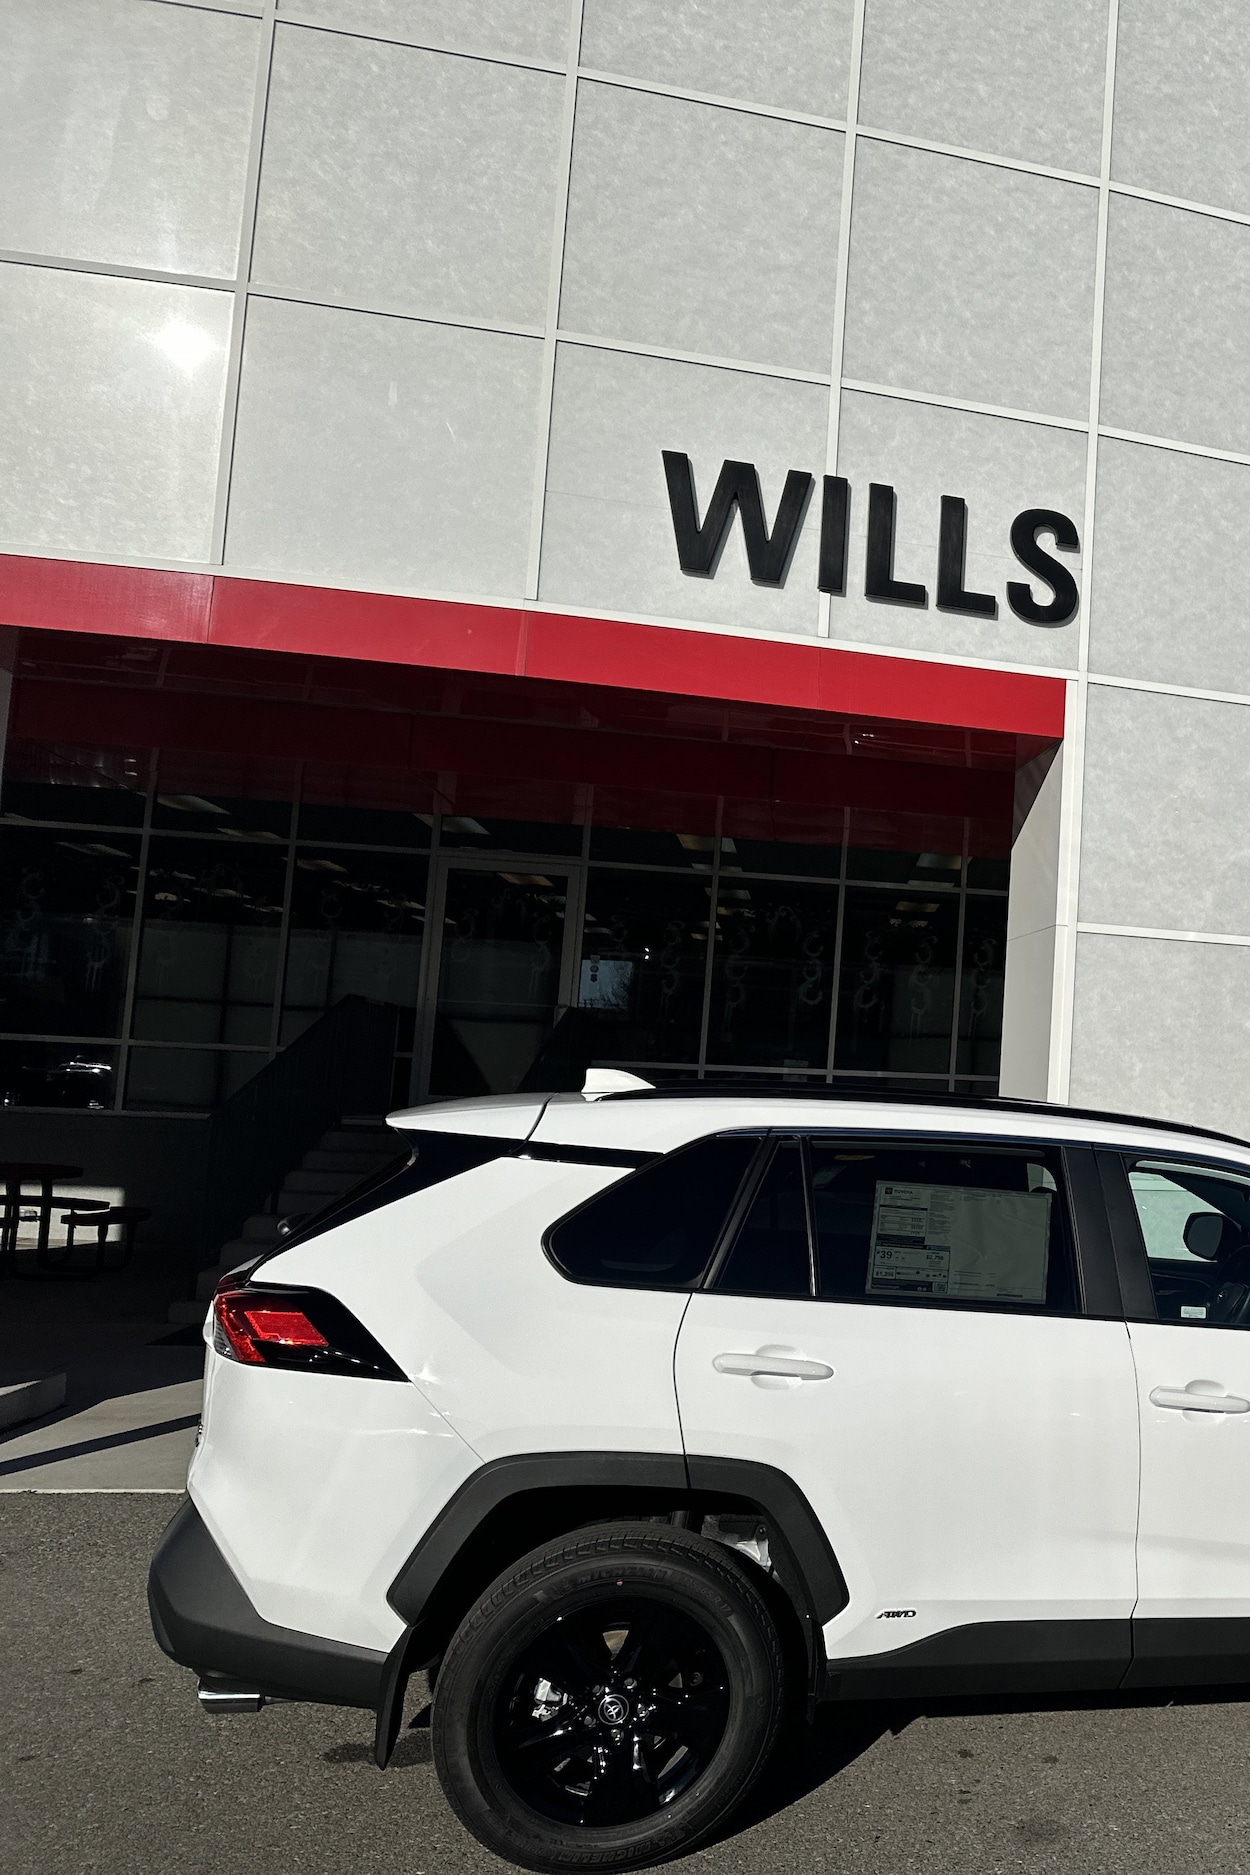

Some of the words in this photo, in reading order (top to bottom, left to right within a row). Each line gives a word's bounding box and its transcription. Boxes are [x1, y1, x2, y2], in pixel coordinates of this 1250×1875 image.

[661, 450, 1080, 625] WILLS
[880, 1250, 892, 1259] 39
[575, 1565, 668, 1586] MICHELIN
[875, 1609, 917, 1620] AWD
[557, 1841, 652, 1865] MICHELIN
